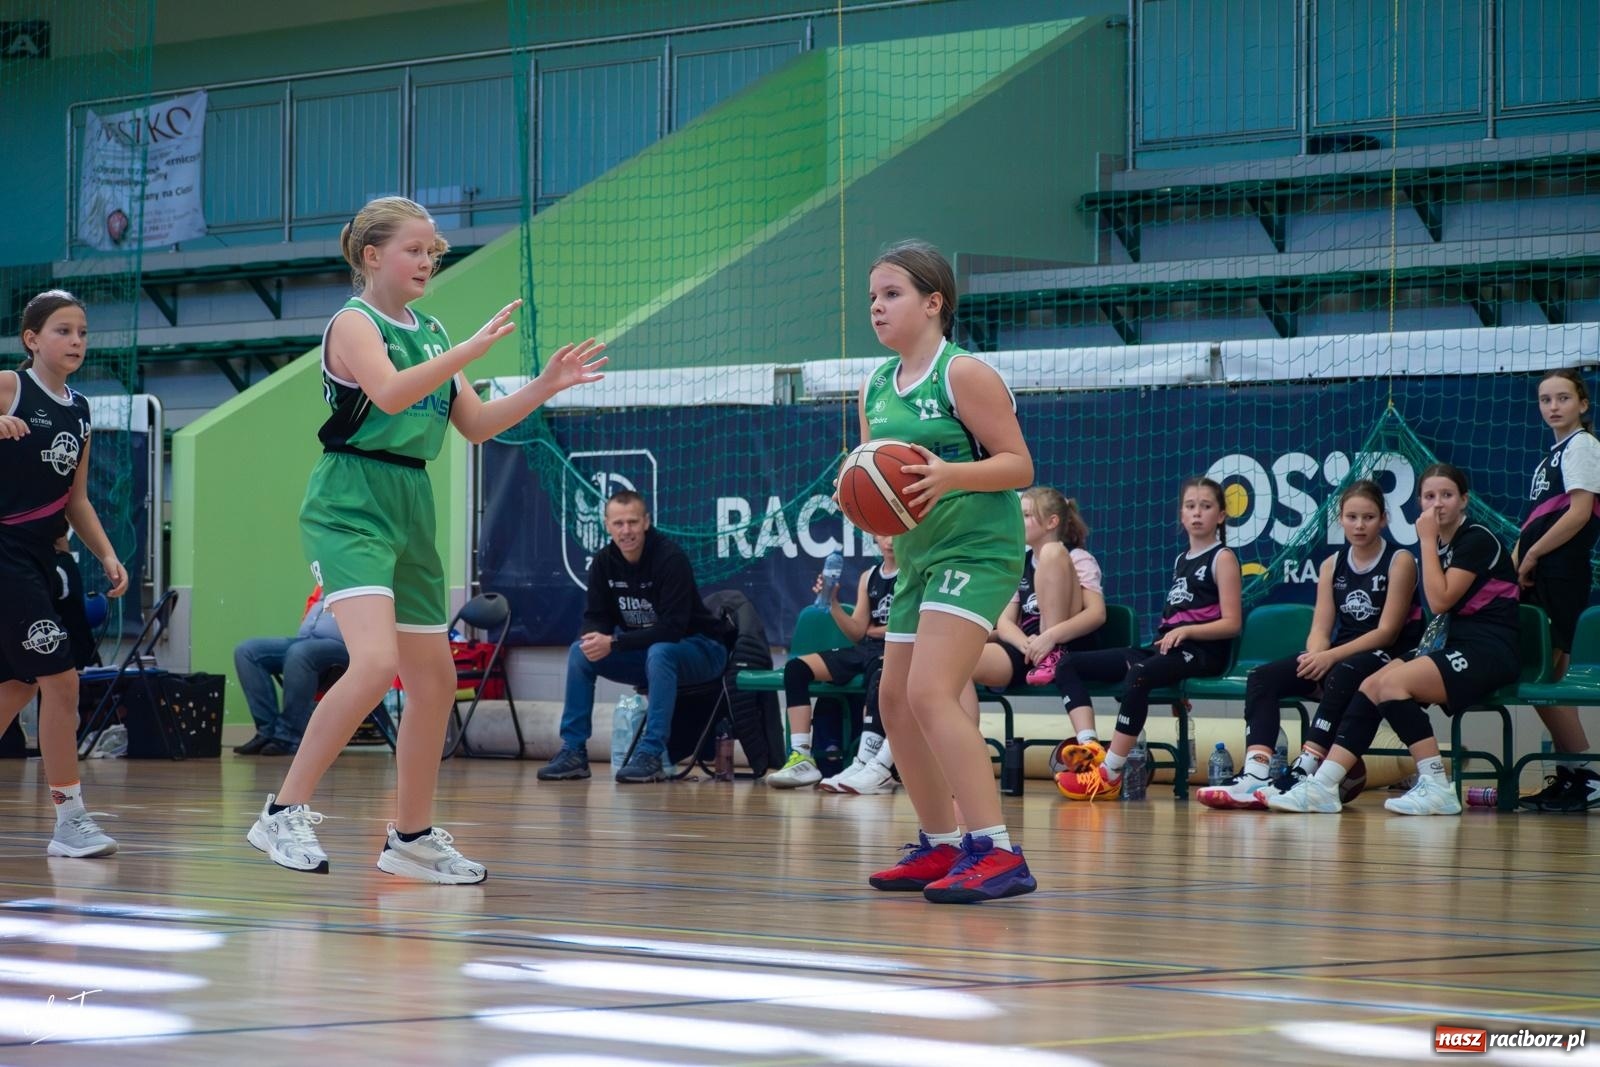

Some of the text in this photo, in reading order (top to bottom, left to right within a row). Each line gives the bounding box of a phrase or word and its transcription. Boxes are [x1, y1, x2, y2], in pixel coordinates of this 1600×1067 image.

[938, 568, 971, 597] 17
[1194, 565, 1208, 581] 4
[1283, 558, 1320, 584] RA
[1445, 650, 1469, 673] 18
